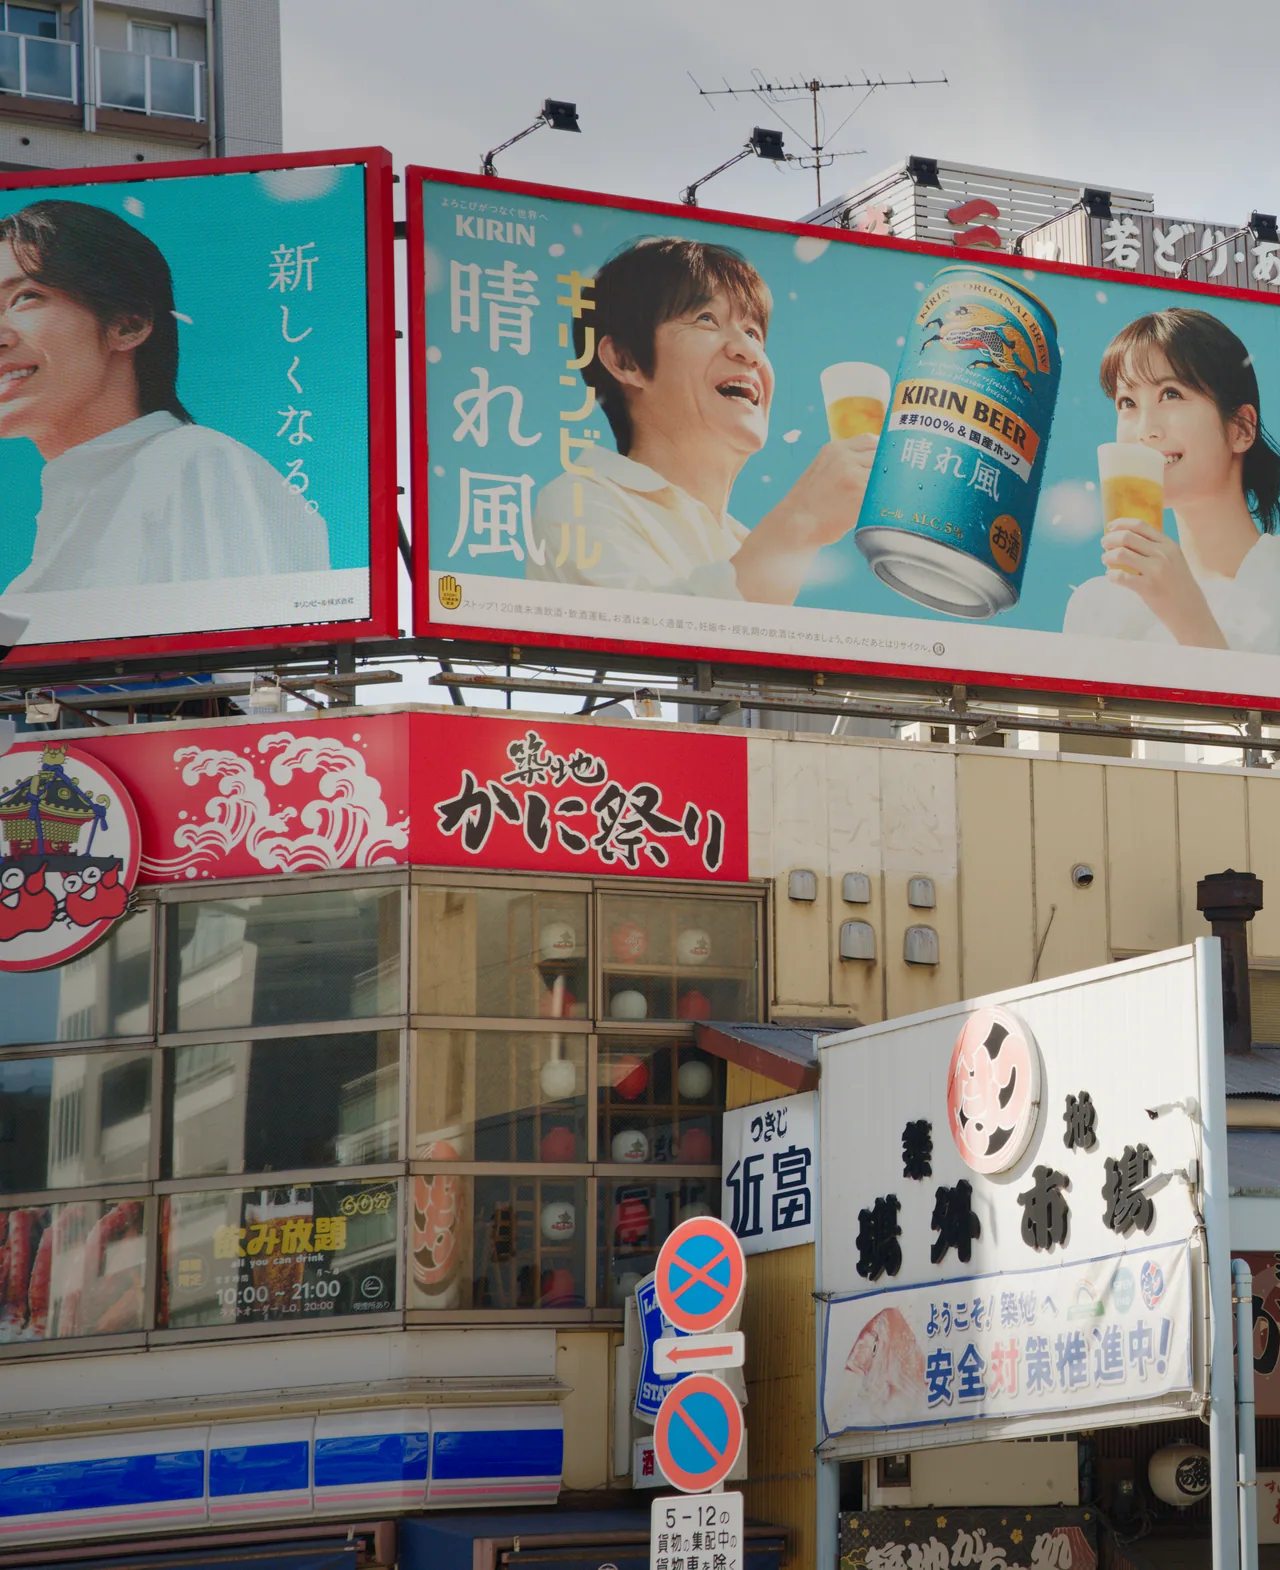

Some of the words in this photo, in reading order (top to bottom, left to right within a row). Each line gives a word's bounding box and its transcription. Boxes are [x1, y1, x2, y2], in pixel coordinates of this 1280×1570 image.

[441, 197, 548, 221] よろこびがつなぐ世界へ
[456, 214, 536, 247] KIRIN
[1029, 322, 1050, 368] BREW
[268, 241, 320, 514] 新しくなる。
[447, 259, 546, 566] 晴れ風
[556, 269, 599, 570] キリンビール
[901, 385, 969, 415] KIRIN
[972, 400, 1027, 451] BEER
[900, 438, 1001, 502] 晴れ風
[881, 508, 903, 519] ビール
[992, 524, 1021, 564] お酒
[501, 730, 607, 786] 築地
[434, 769, 725, 873] かに祭り
[751, 1106, 788, 1142] つきじ
[726, 1144, 811, 1239] 近富
[213, 1216, 347, 1259] 飲み放題
[231, 1257, 245, 1268] all
[250, 1256, 268, 1269] you
[273, 1255, 291, 1266] can
[295, 1252, 324, 1264] drink
[216, 1284, 268, 1305] 10:00
[291, 1279, 341, 1300] 21:00
[643, 1382, 675, 1402] STAT
[657, 1529, 738, 1553] 貨物の集配中の
